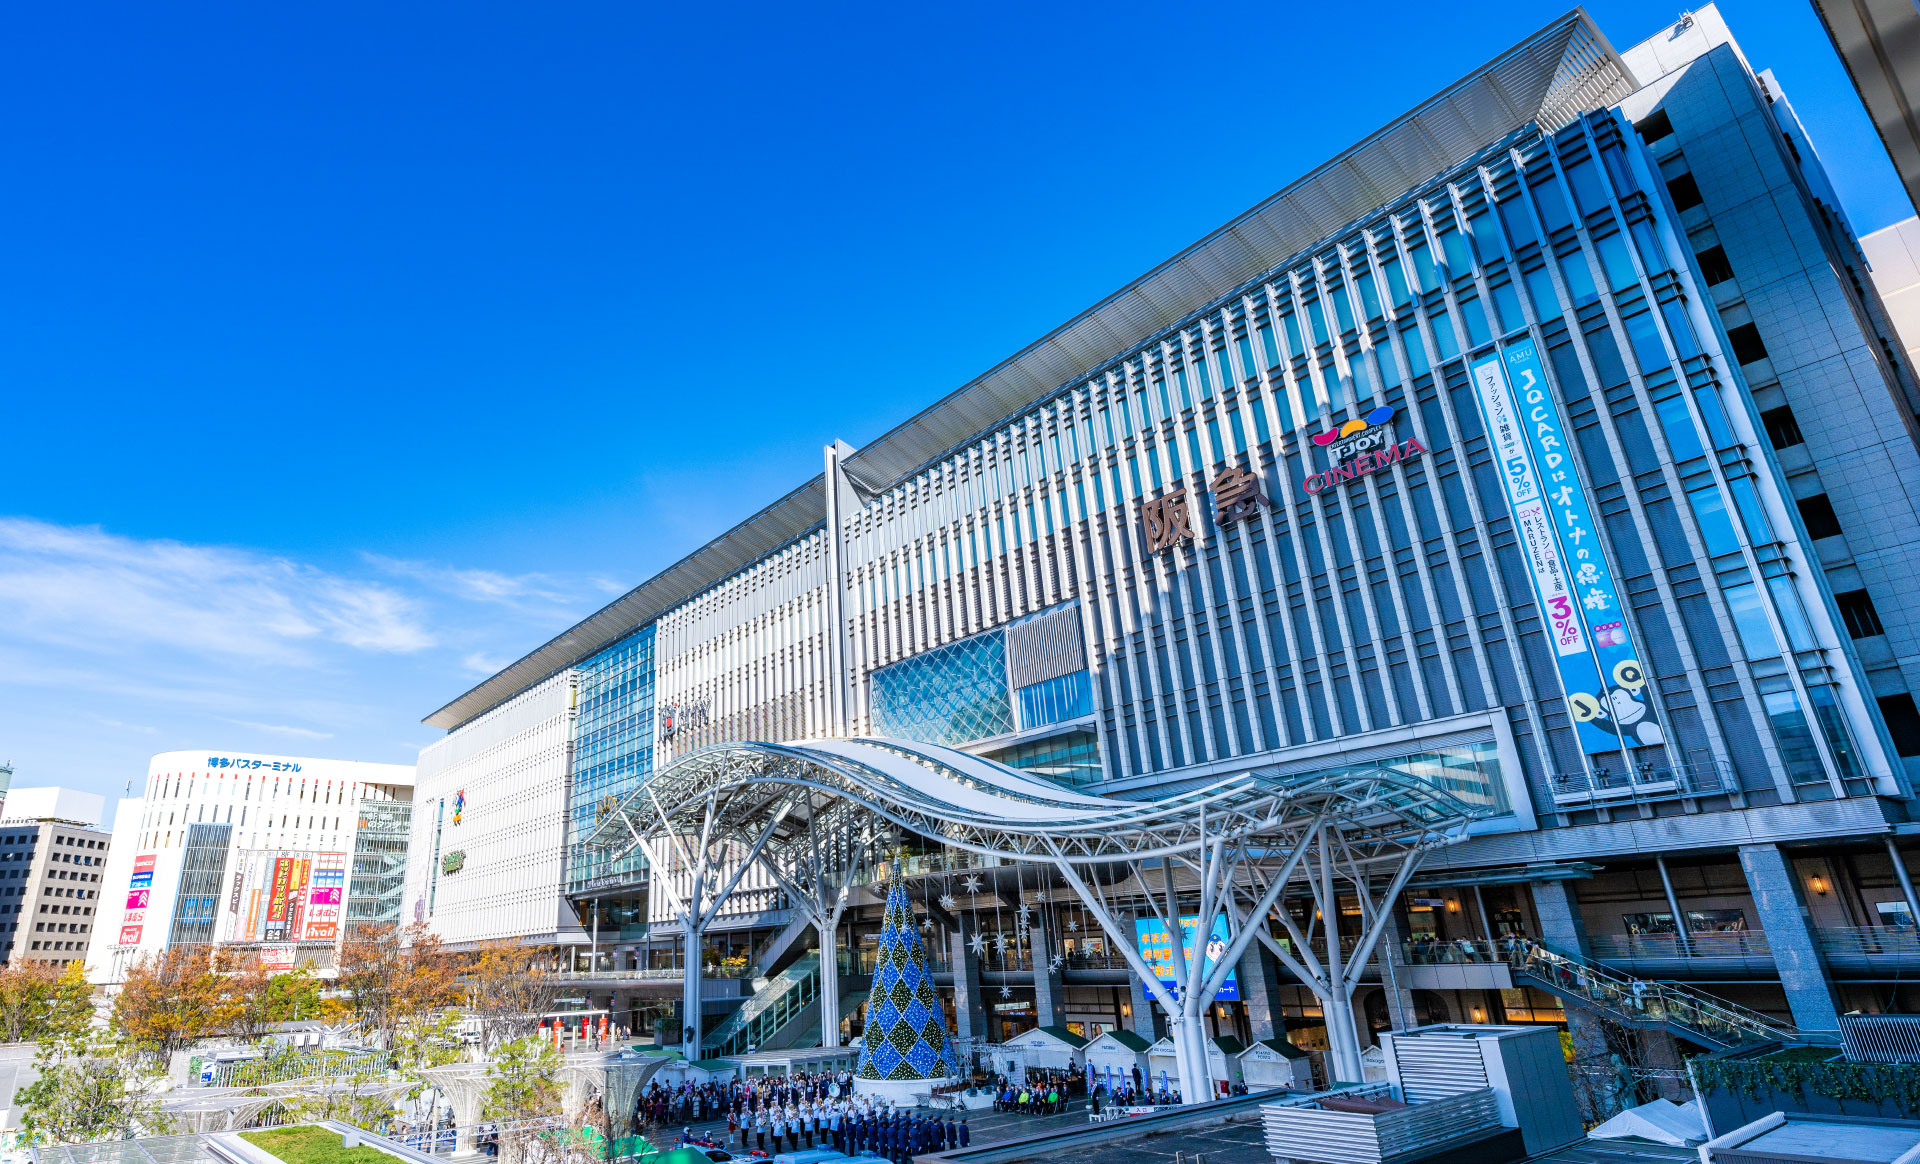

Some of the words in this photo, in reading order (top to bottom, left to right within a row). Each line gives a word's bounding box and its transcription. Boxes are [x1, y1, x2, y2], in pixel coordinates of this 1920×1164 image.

[1509, 348, 1532, 363] AMU
[1500, 424, 1513, 442] 雑貨
[1303, 437, 1426, 494] CINEMA
[1516, 488, 1532, 498] OFF
[1141, 466, 1270, 554] 阪急
[1534, 516, 1550, 549] レストラン
[1559, 635, 1579, 646] OFF
[1620, 666, 1642, 682] Q
[1574, 700, 1591, 717] J
[208, 757, 302, 773] 博多バスターミナル
[124, 911, 145, 922] しまむら
[309, 908, 339, 917] しまむら
[307, 926, 335, 937] Avail
